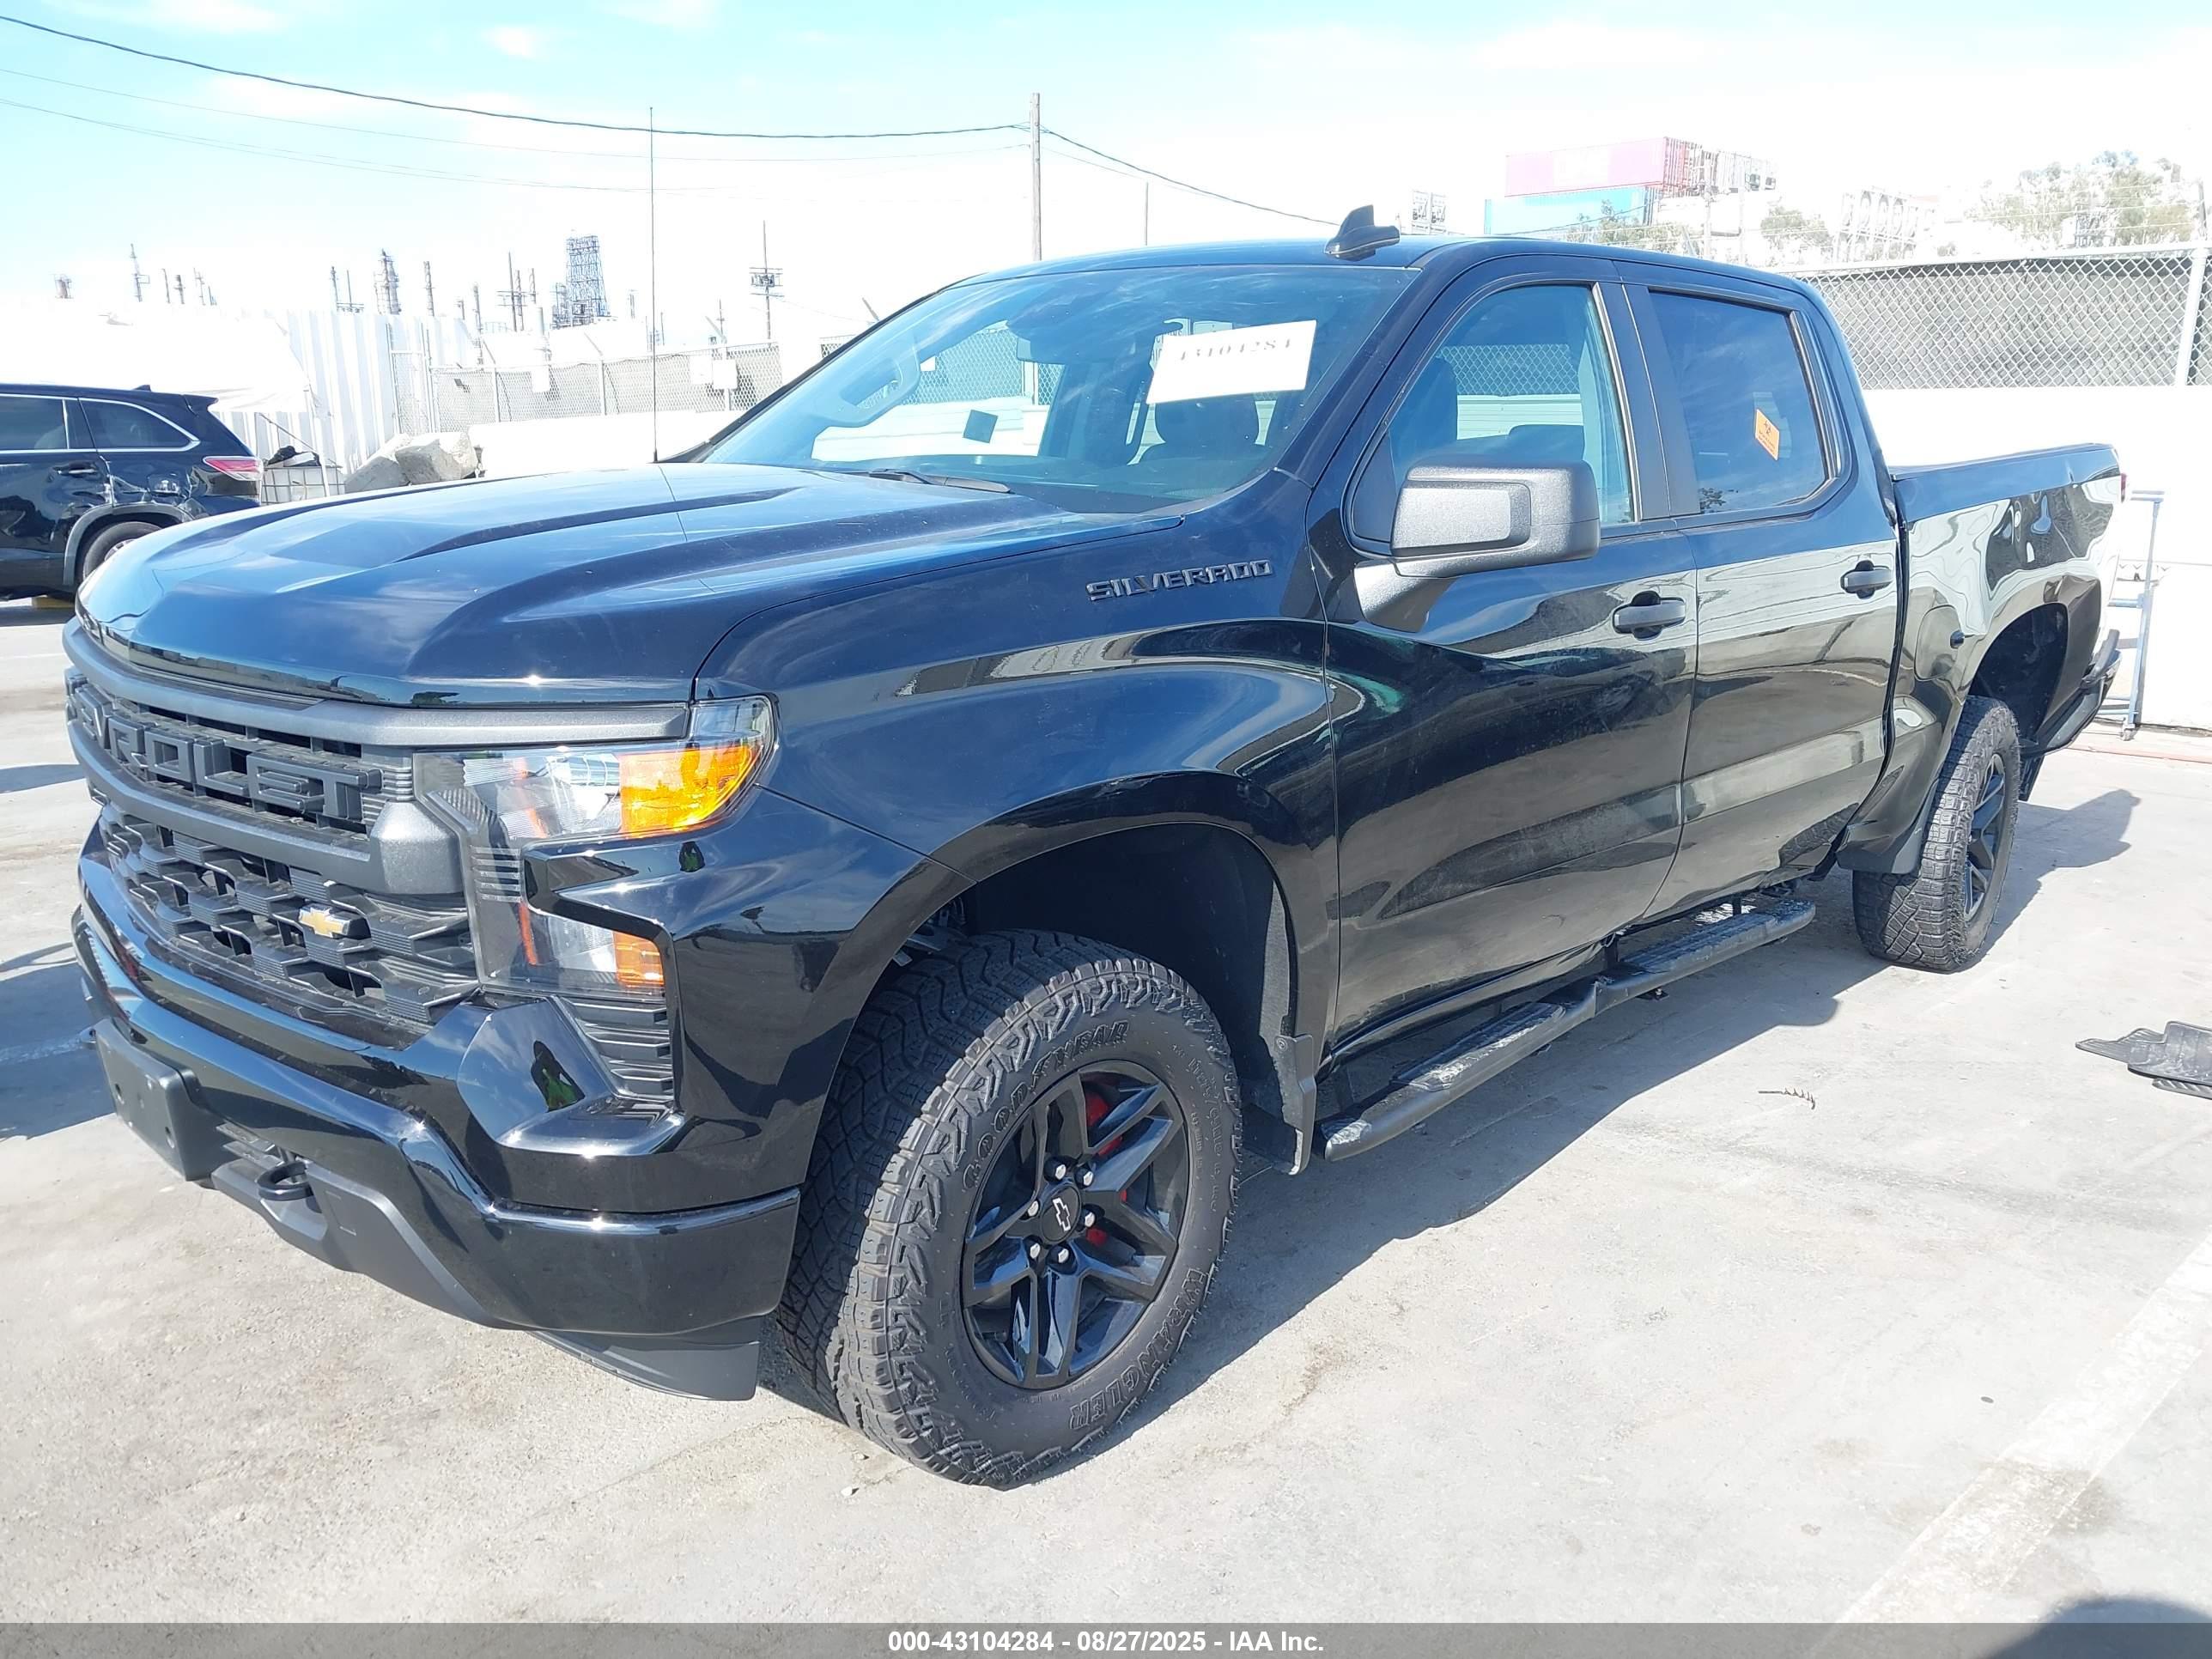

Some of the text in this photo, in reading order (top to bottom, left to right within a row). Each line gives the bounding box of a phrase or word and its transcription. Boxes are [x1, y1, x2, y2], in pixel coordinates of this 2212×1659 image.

[1085, 559, 1273, 602] SILVERADO
[962, 1019, 1130, 1193] GOODYEAR
[1069, 1267, 1206, 1431] WRANGLER
